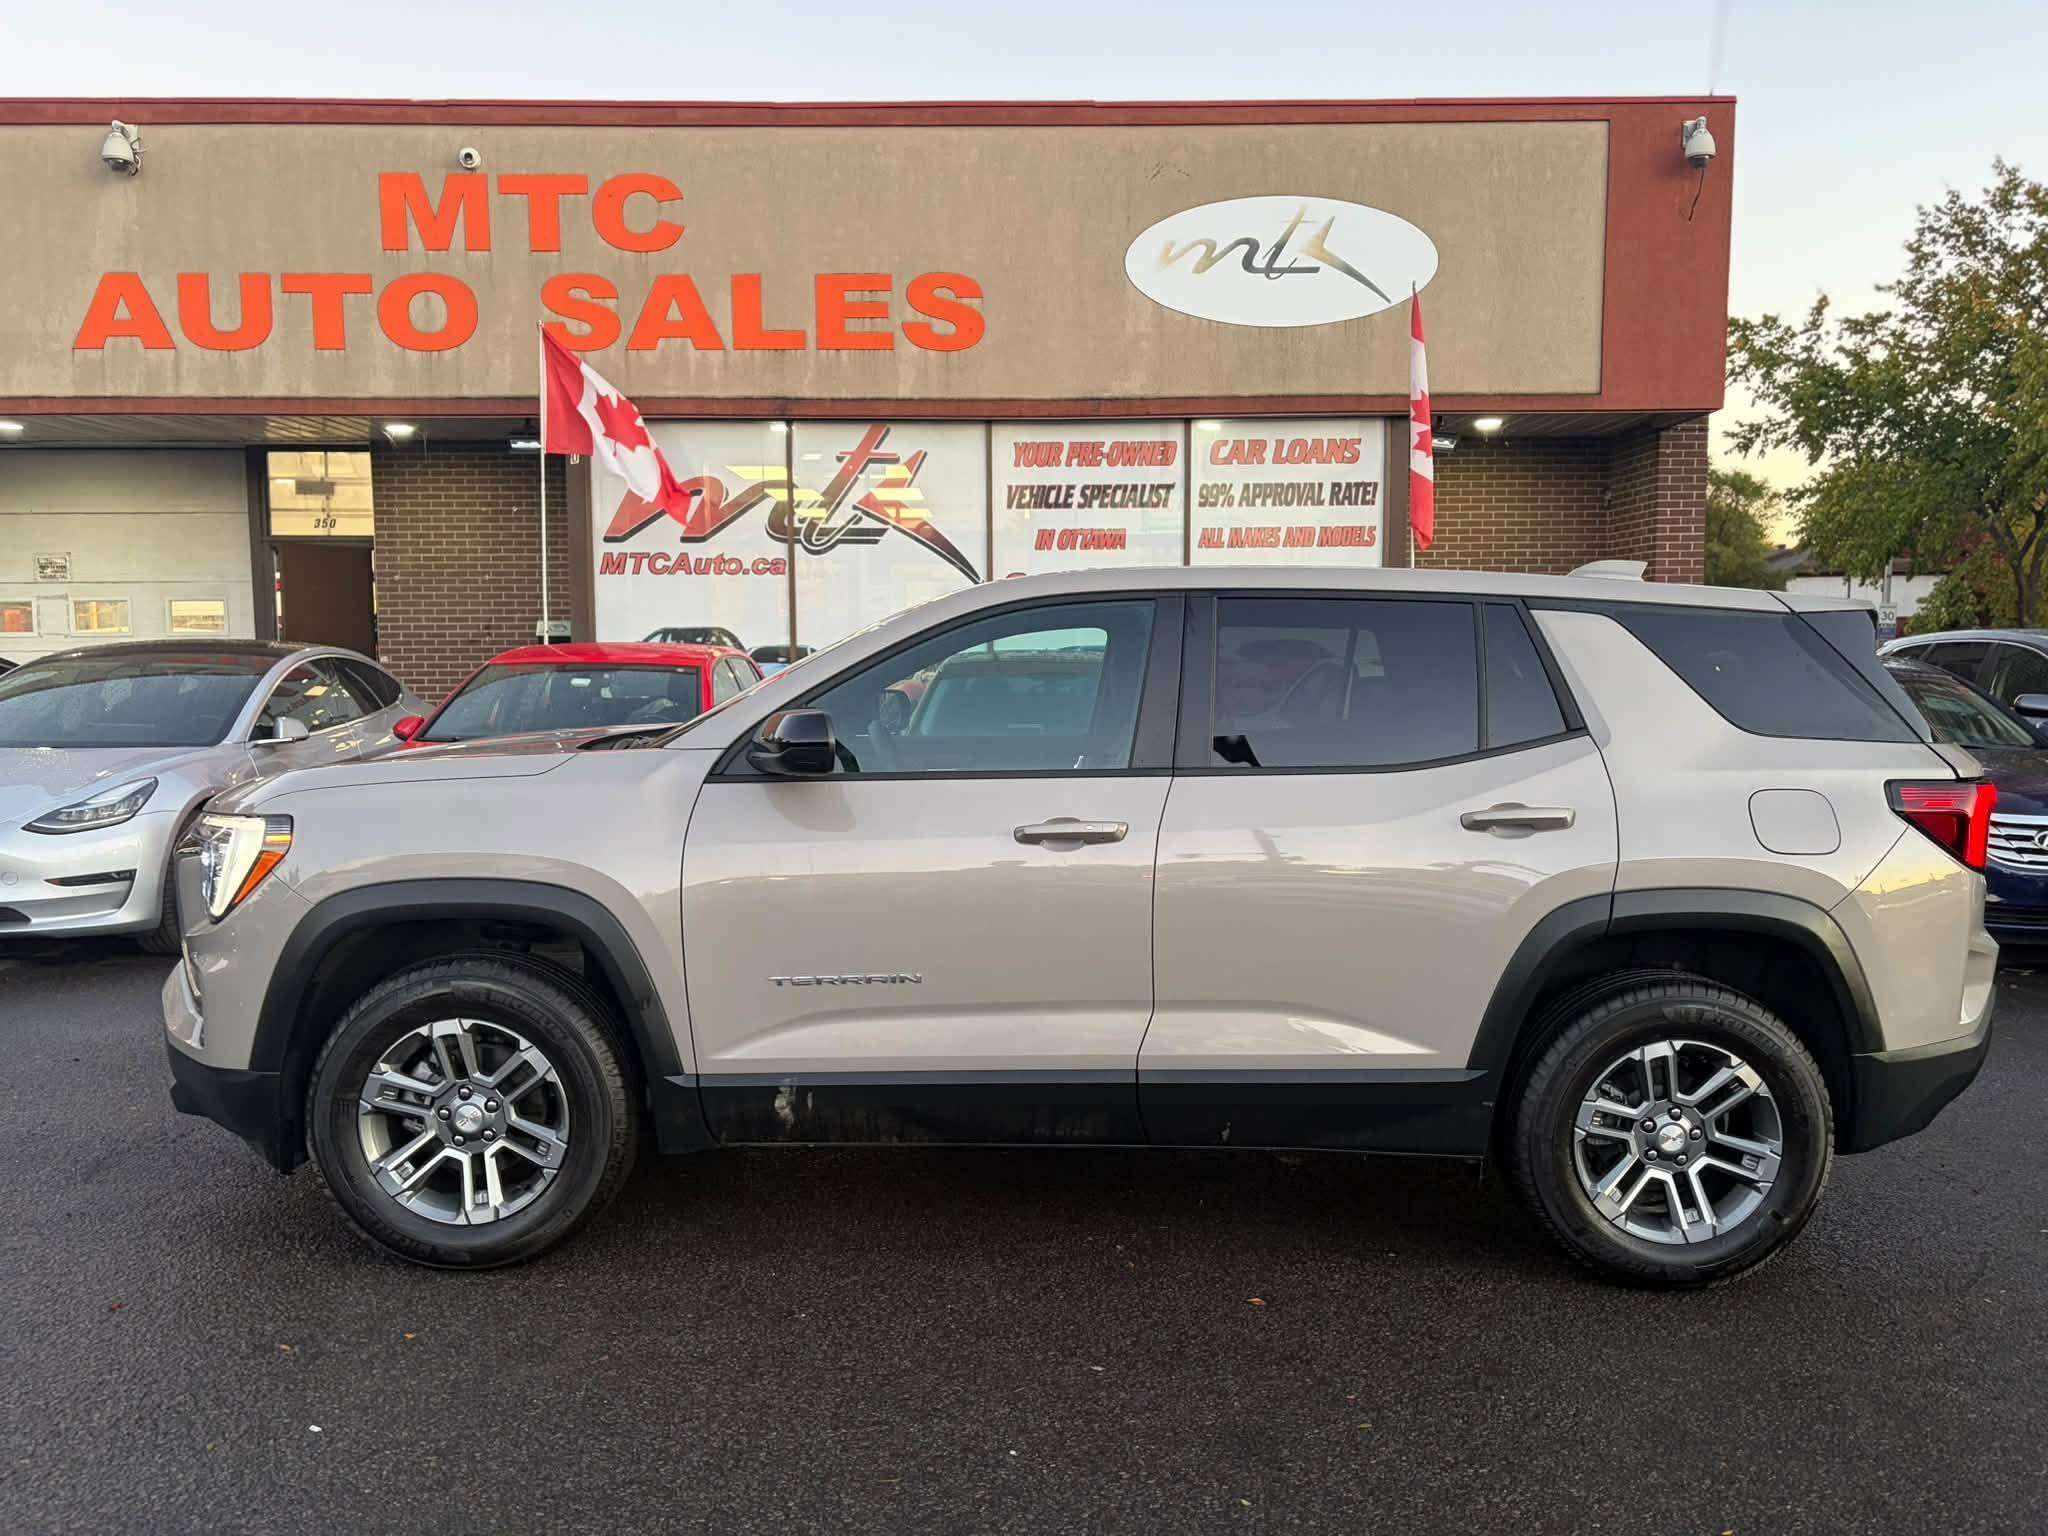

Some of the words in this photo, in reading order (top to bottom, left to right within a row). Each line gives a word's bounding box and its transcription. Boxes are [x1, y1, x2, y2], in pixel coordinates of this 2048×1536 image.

[378, 172, 685, 253] MTC
[72, 271, 479, 352] AUTO
[540, 271, 986, 352] SALES
[1013, 441, 1064, 468] YOUR
[1065, 440, 1178, 468] PRE-OWNED
[1209, 438, 1268, 466] CAR
[1271, 437, 1362, 465] LOANS
[1006, 484, 1077, 510] VEHICLE
[1076, 482, 1177, 509] SPECIALIST
[1198, 483, 1235, 508] 99%
[1237, 482, 1326, 508] APPROVAL
[1327, 480, 1379, 507] RATE!
[313, 518, 337, 529] 350
[1034, 529, 1056, 551] IN
[1056, 528, 1127, 551] OTTAWA
[1197, 527, 1225, 549] ALL
[1226, 527, 1282, 549] MAKES
[1281, 526, 1316, 548] AND
[1316, 525, 1377, 548] MODELS
[600, 551, 787, 576] MTCAuto.ca
[1880, 611, 1895, 621] 30
[768, 973, 923, 986] TERRAIN
